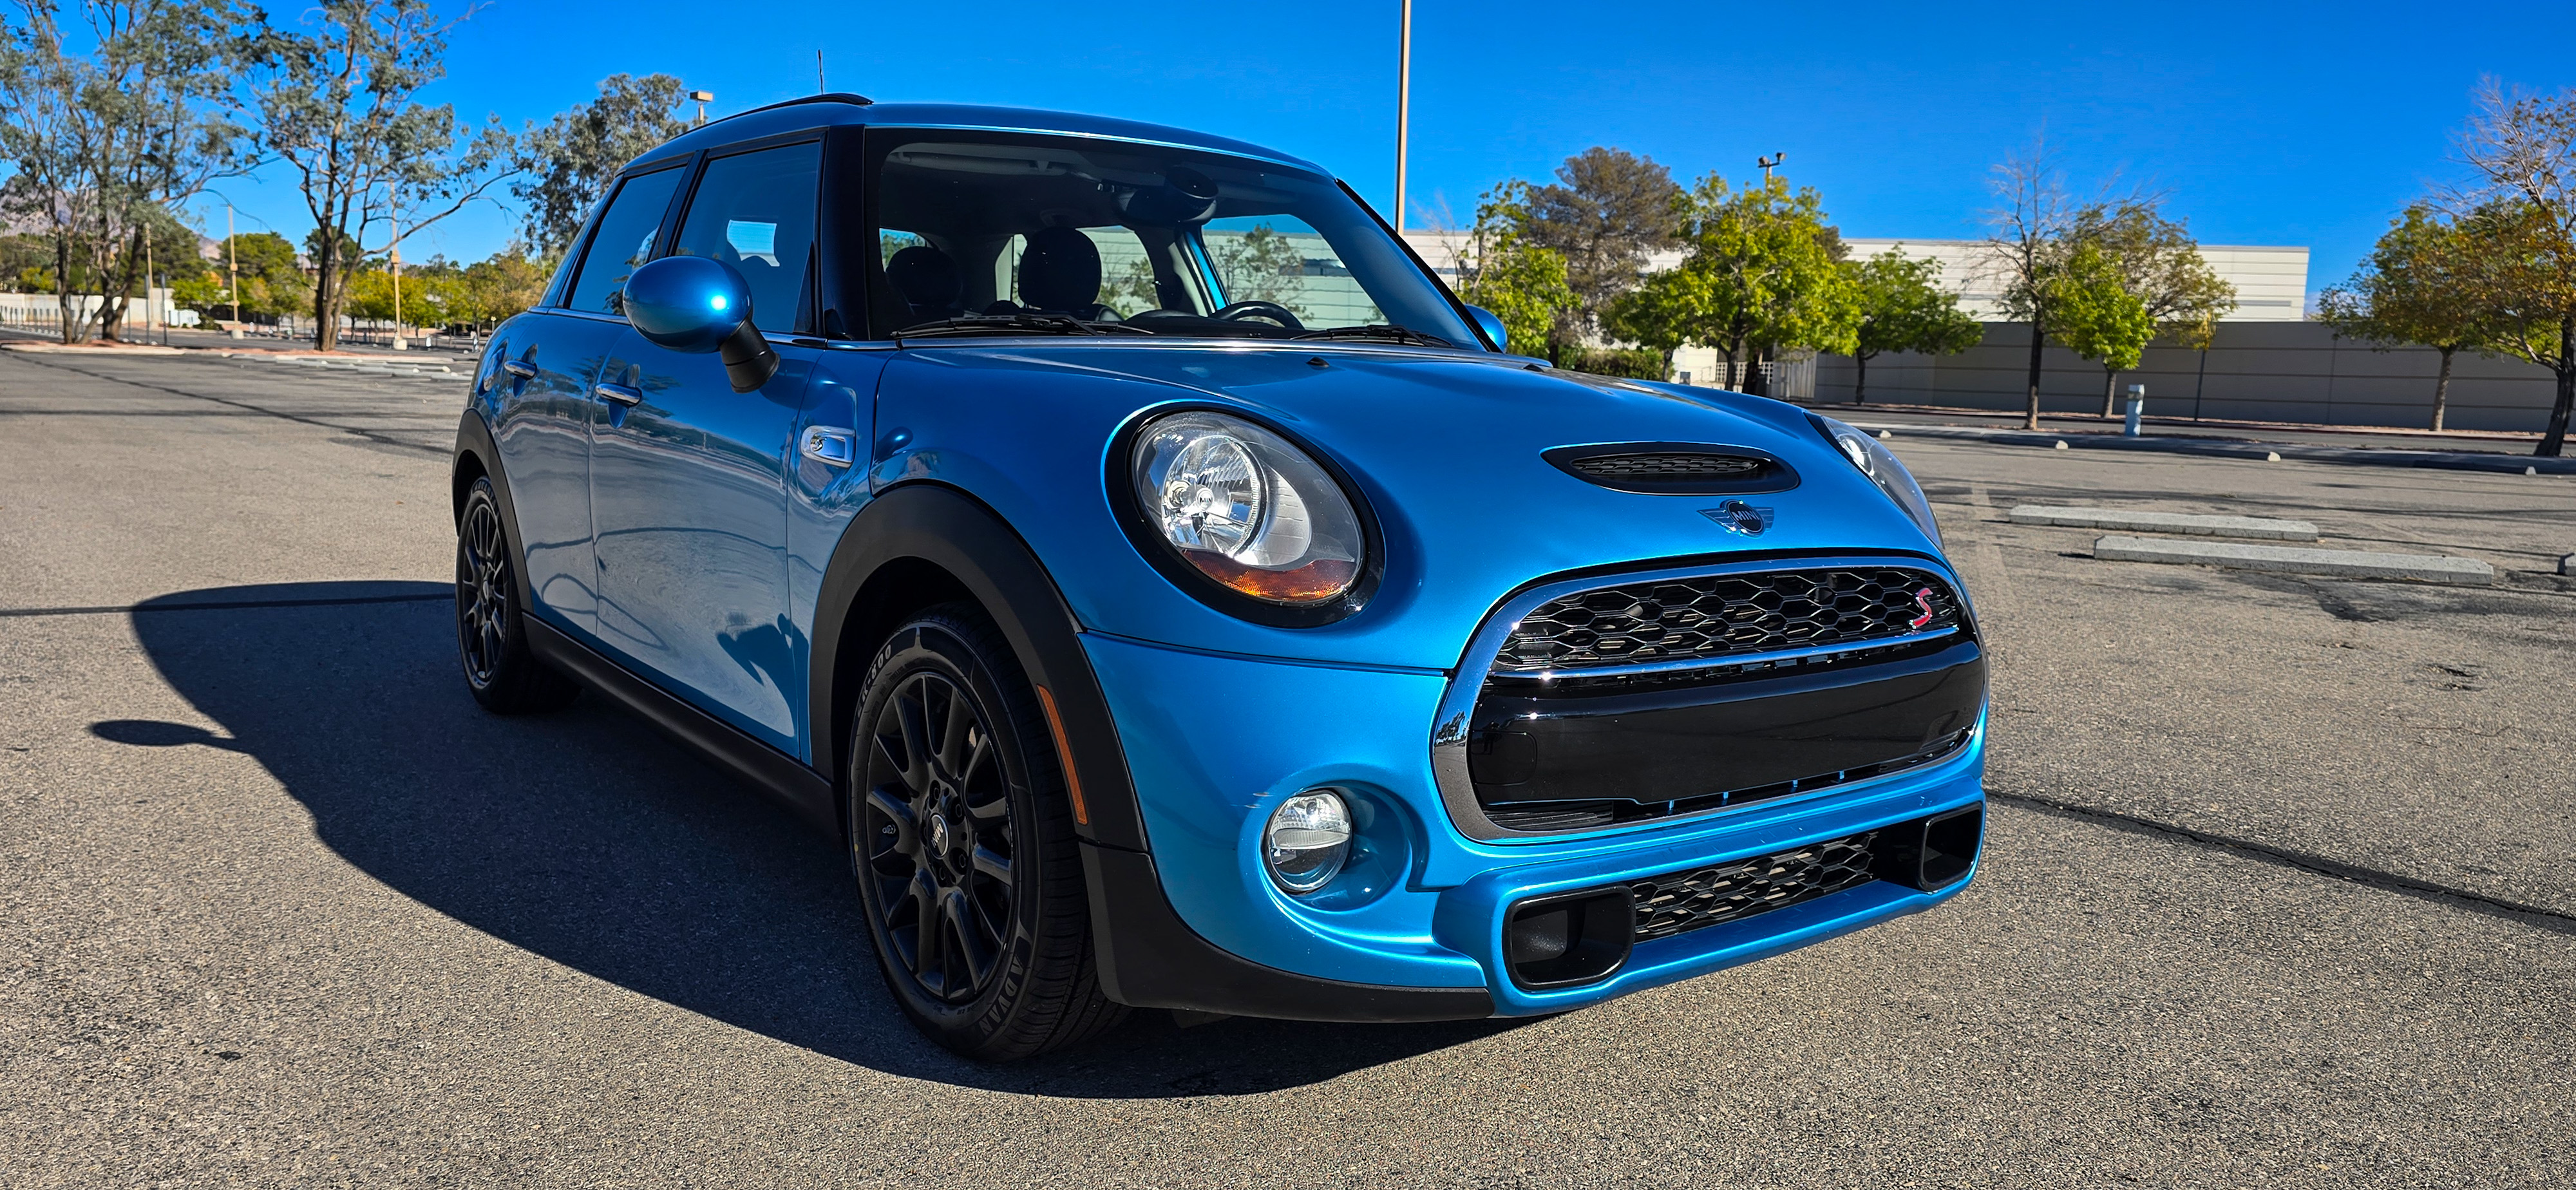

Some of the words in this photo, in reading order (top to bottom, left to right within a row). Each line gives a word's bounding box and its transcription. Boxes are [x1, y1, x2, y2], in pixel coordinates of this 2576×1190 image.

[1731, 510, 1761, 521] MINI
[1908, 587, 1933, 629] S
[931, 822, 945, 849] MINI
